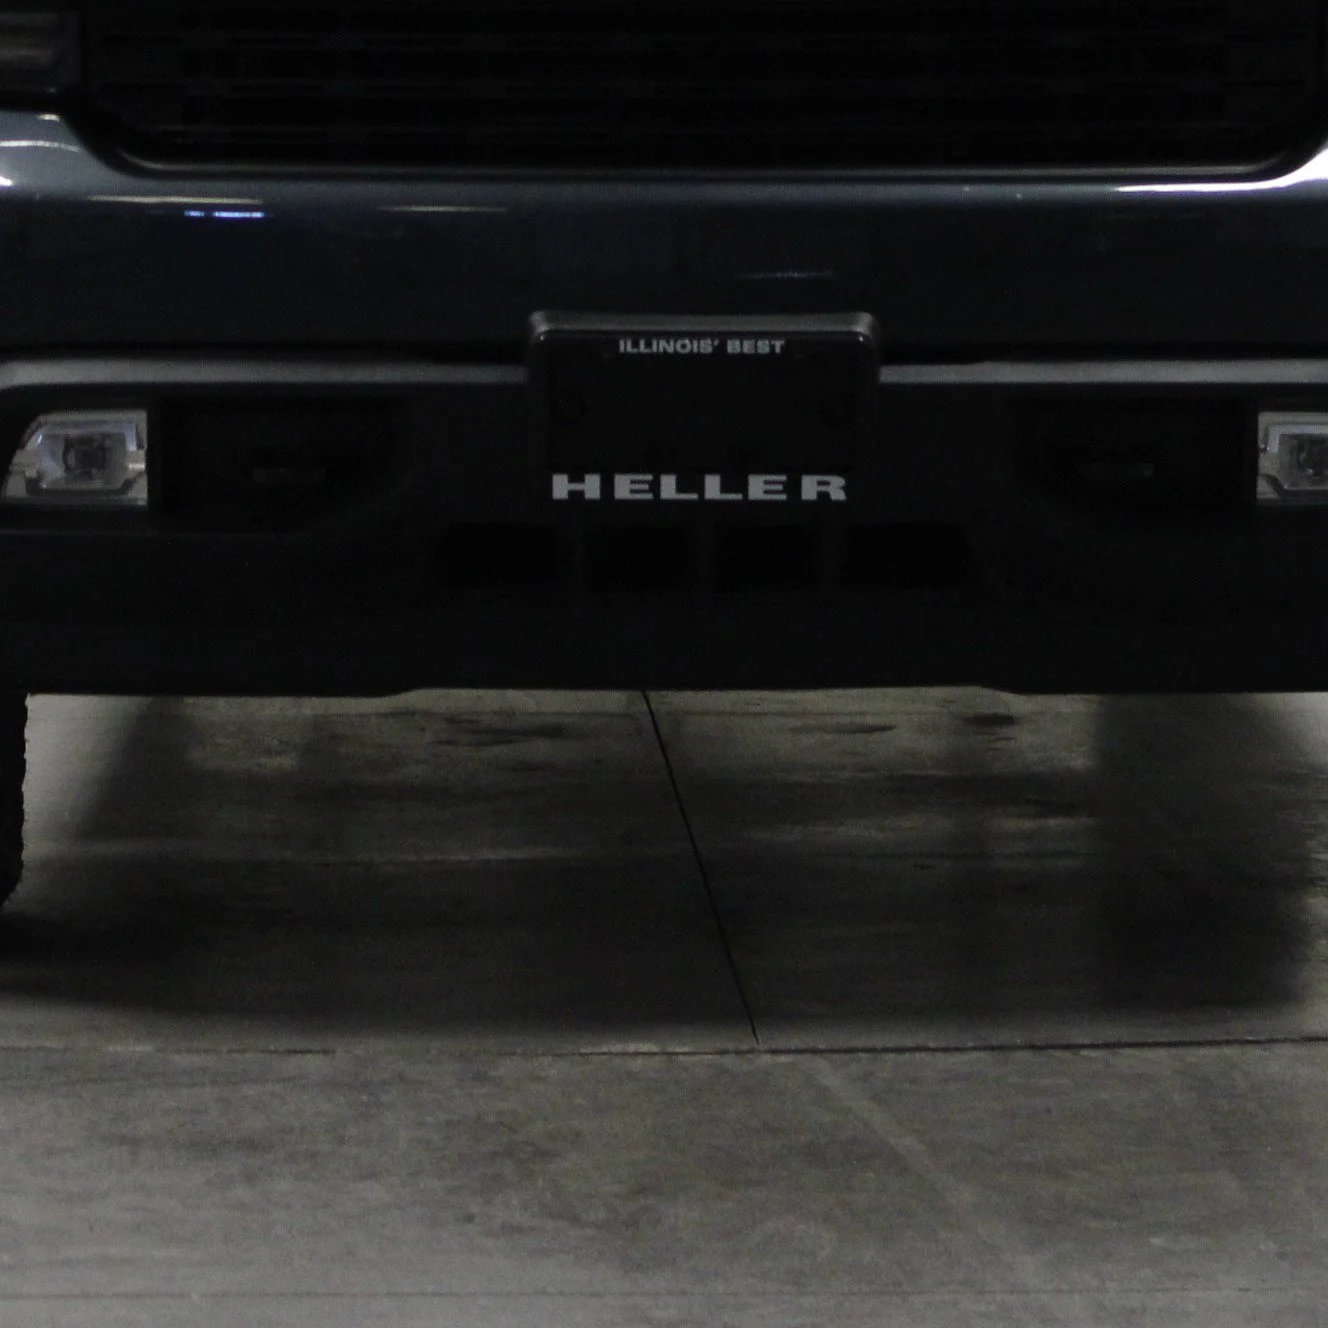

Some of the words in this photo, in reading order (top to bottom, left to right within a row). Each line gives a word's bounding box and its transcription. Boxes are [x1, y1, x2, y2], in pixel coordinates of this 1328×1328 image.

[618, 338, 720, 354] ILLINOIS'
[727, 339, 785, 354] BEST
[552, 474, 847, 501] HELLER
